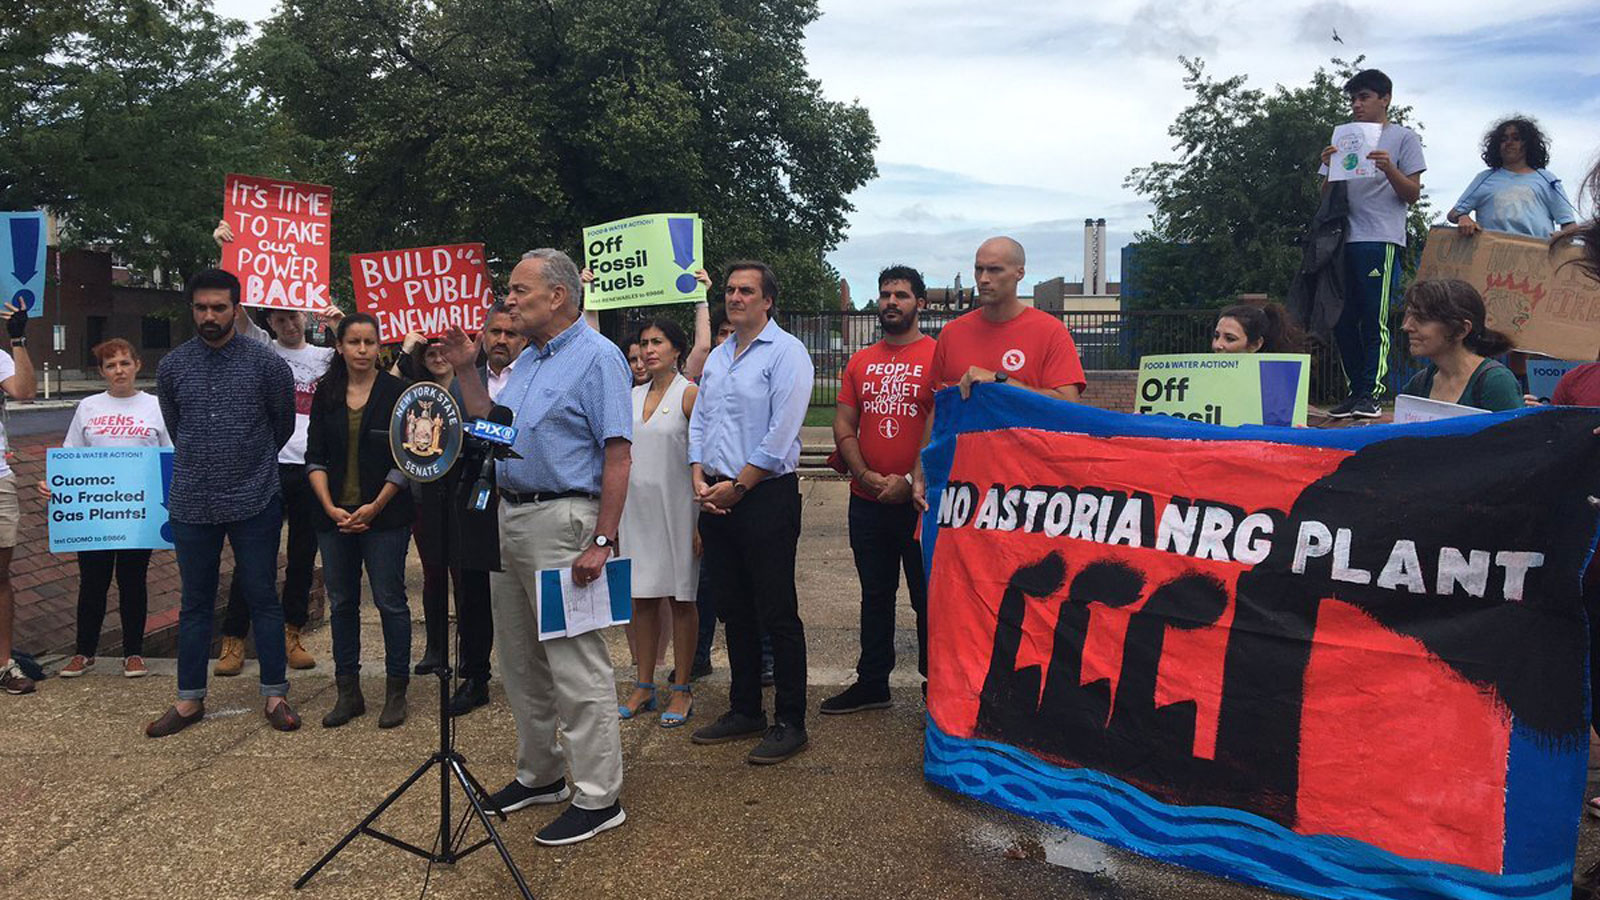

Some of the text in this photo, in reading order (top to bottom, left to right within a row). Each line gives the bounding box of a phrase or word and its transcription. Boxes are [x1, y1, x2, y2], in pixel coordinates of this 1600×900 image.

[232, 180, 328, 216] IT'S TIME
[234, 211, 326, 246] TO TAKE
[589, 235, 623, 257] Off
[238, 248, 318, 283] POWER
[360, 249, 452, 288] BUILD
[590, 250, 648, 273] Fossil
[246, 274, 329, 308] BACK
[403, 273, 495, 309] PUBLIC
[590, 272, 645, 293] Fuels
[375, 304, 485, 341] ENEWABLE
[866, 363, 923, 377] PEOPLE
[1144, 360, 1239, 370] FOOD & WATER ACTION!
[862, 381, 920, 397] PLANET
[881, 373, 907, 385] and
[1142, 377, 1189, 402] Off
[395, 387, 458, 426] NEW YORK STATE
[875, 393, 905, 404] over
[104, 426, 151, 437] FUTURE
[405, 460, 440, 477] SENATE
[51, 474, 115, 487] Cuomo:
[51, 490, 145, 505] No Fracked
[52, 507, 147, 522] Gas Plants!
[937, 486, 1545, 601] NO ASTORIA NRG PLANT
